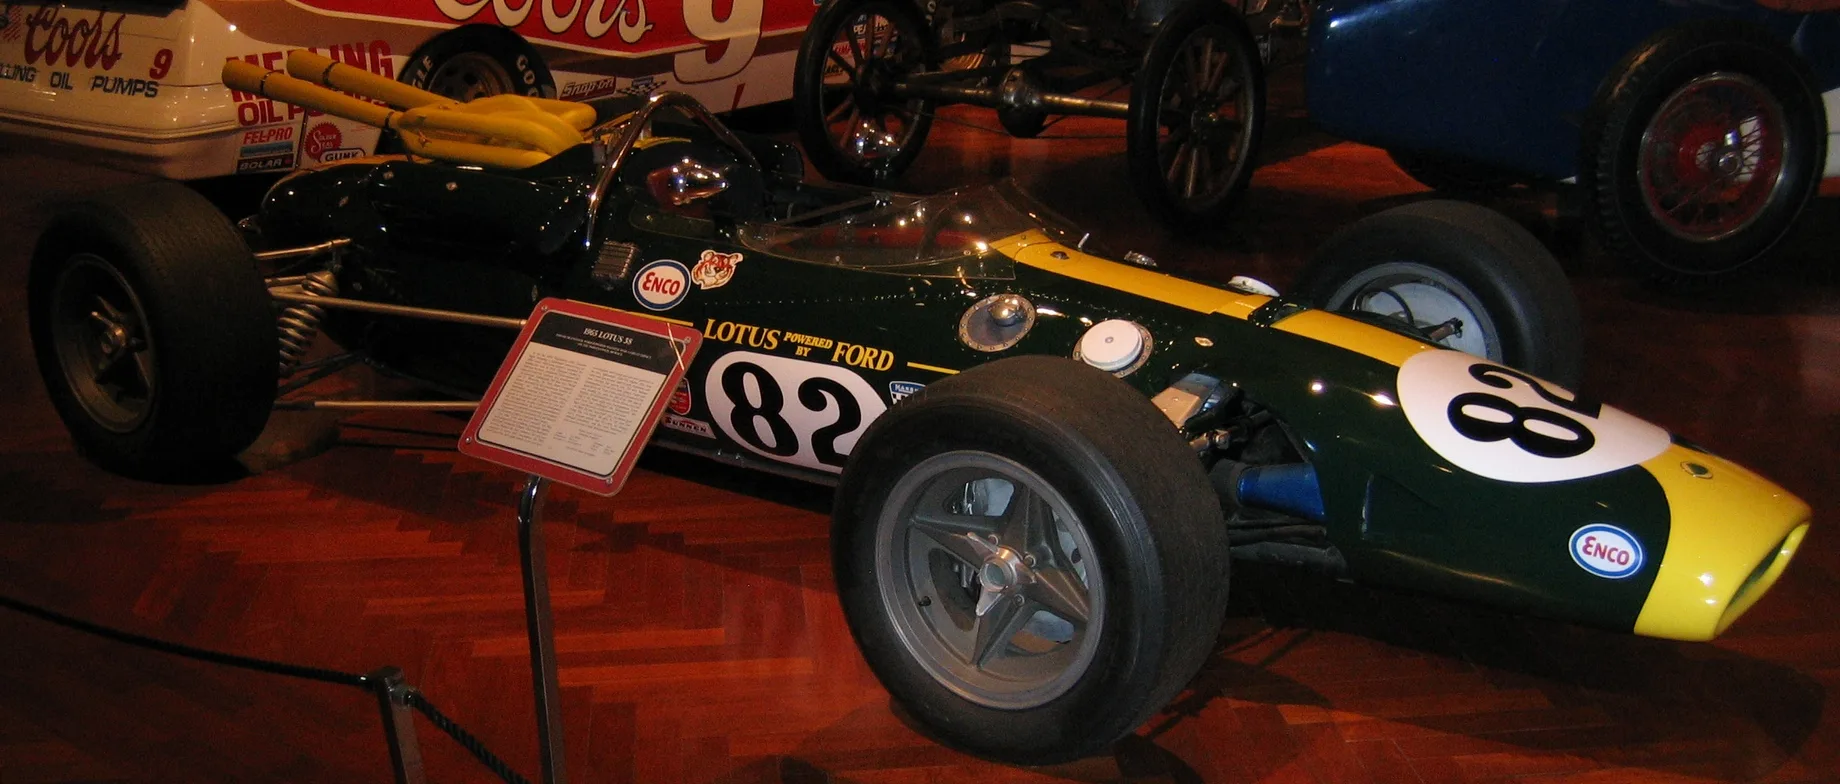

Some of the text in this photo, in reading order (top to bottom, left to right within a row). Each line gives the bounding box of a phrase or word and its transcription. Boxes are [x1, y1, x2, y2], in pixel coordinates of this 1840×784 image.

[149, 48, 174, 80] 9
[50, 71, 73, 91] OIL
[91, 75, 160, 98] PUMPS
[238, 101, 284, 127] OIL
[642, 272, 681, 296] ENCO
[598, 330, 624, 344] LOTUS
[703, 319, 895, 372] LOTUS POWERED FORD
[795, 346, 812, 357] BY
[665, 416, 707, 432] SUNNEN
[721, 361, 861, 464] 82
[1447, 363, 1603, 459] 82
[1582, 536, 1630, 566] ENCO
